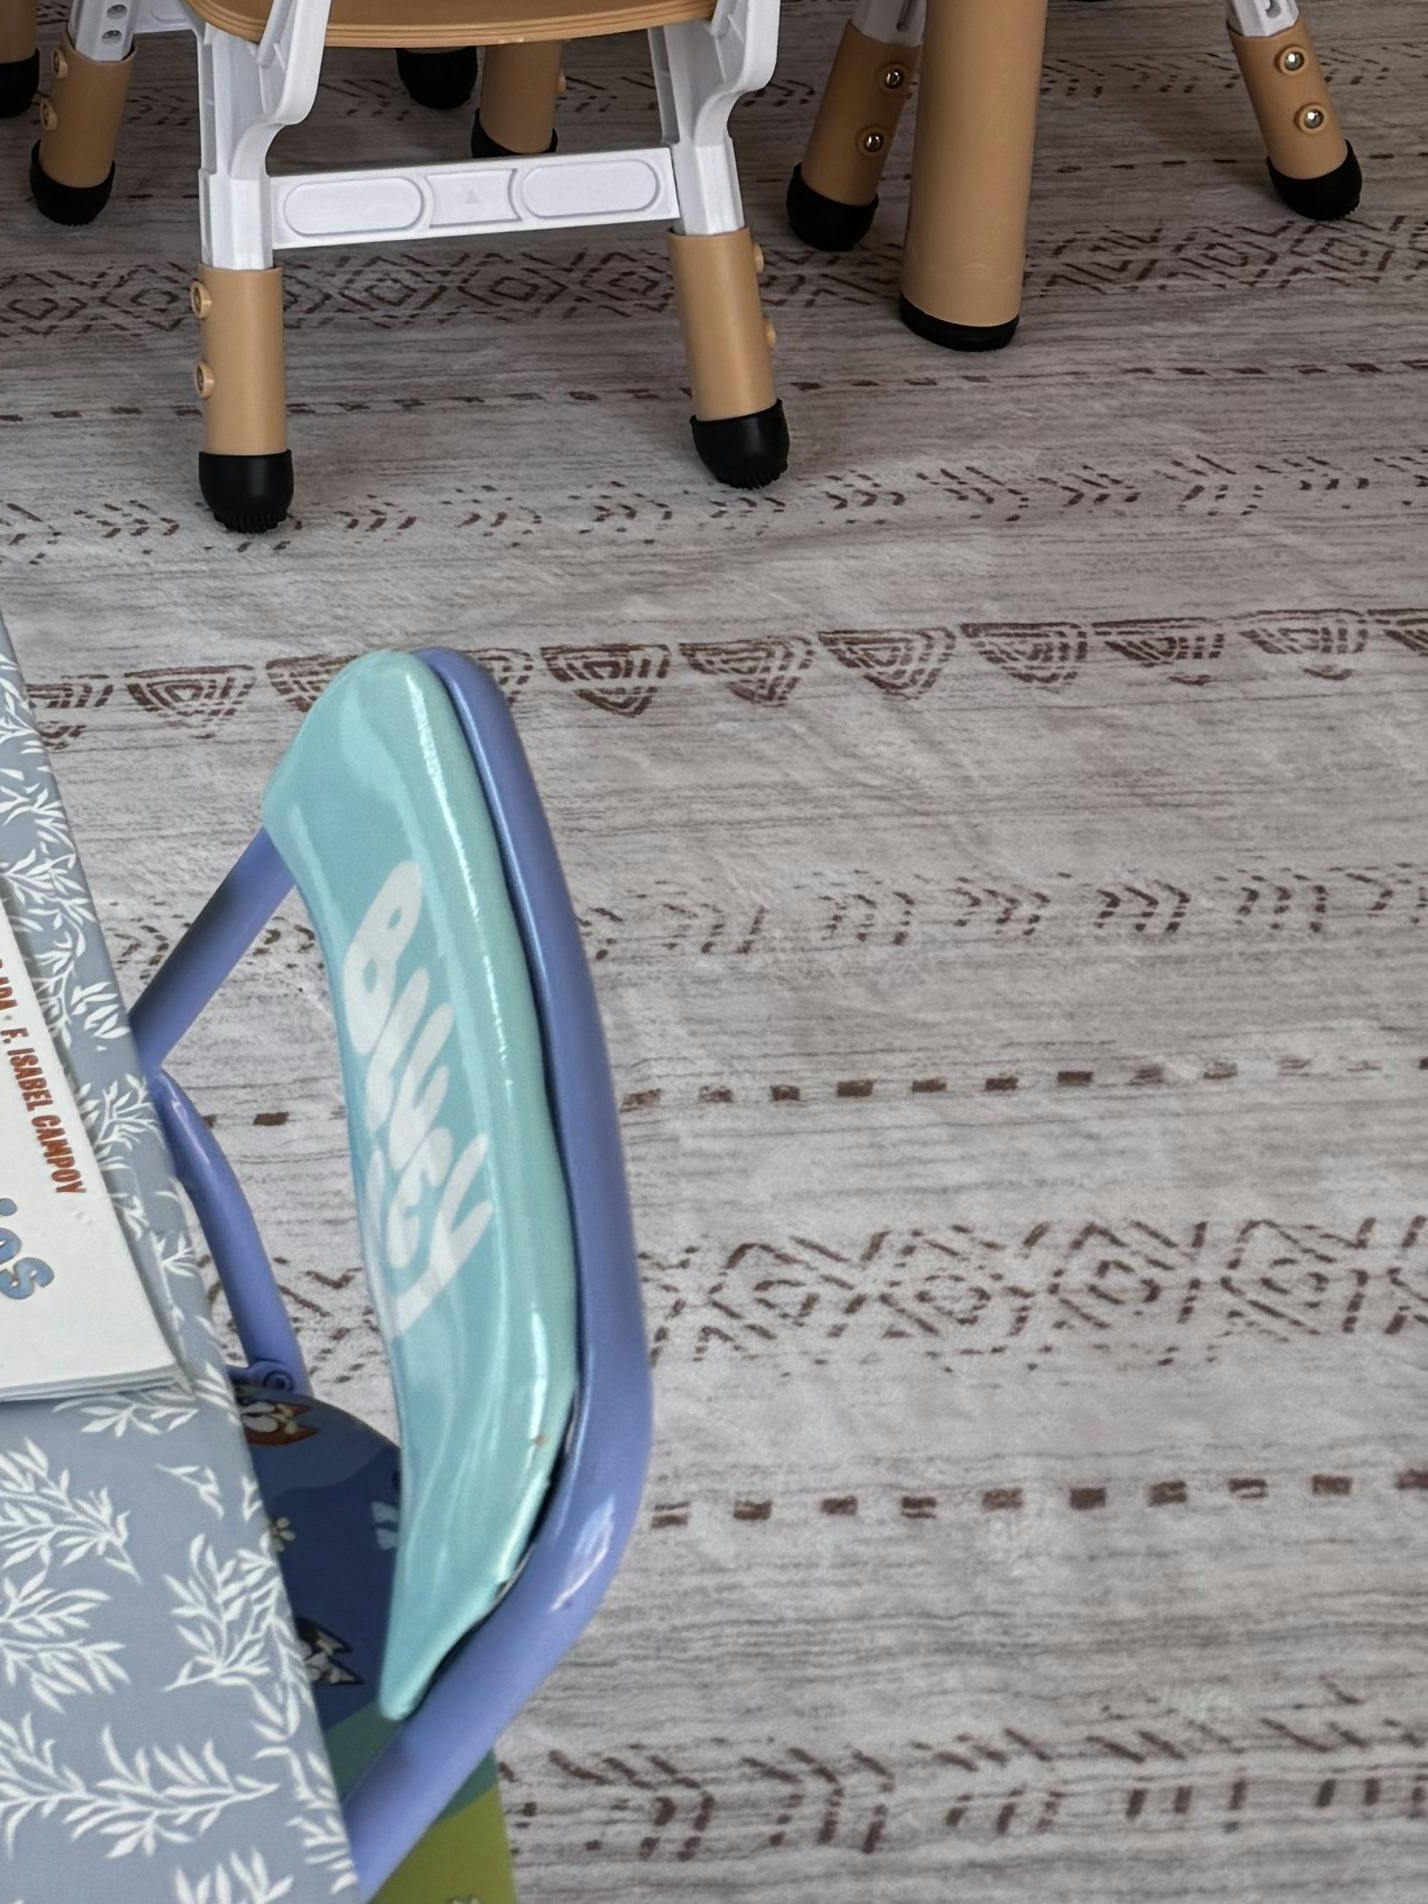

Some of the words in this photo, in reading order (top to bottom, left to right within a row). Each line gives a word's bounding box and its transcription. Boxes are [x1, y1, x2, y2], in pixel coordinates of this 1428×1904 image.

[0, 1028, 31, 1045] F.
[7, 1047, 53, 1112] ISABEL
[34, 1115, 86, 1195] CAMPOY
